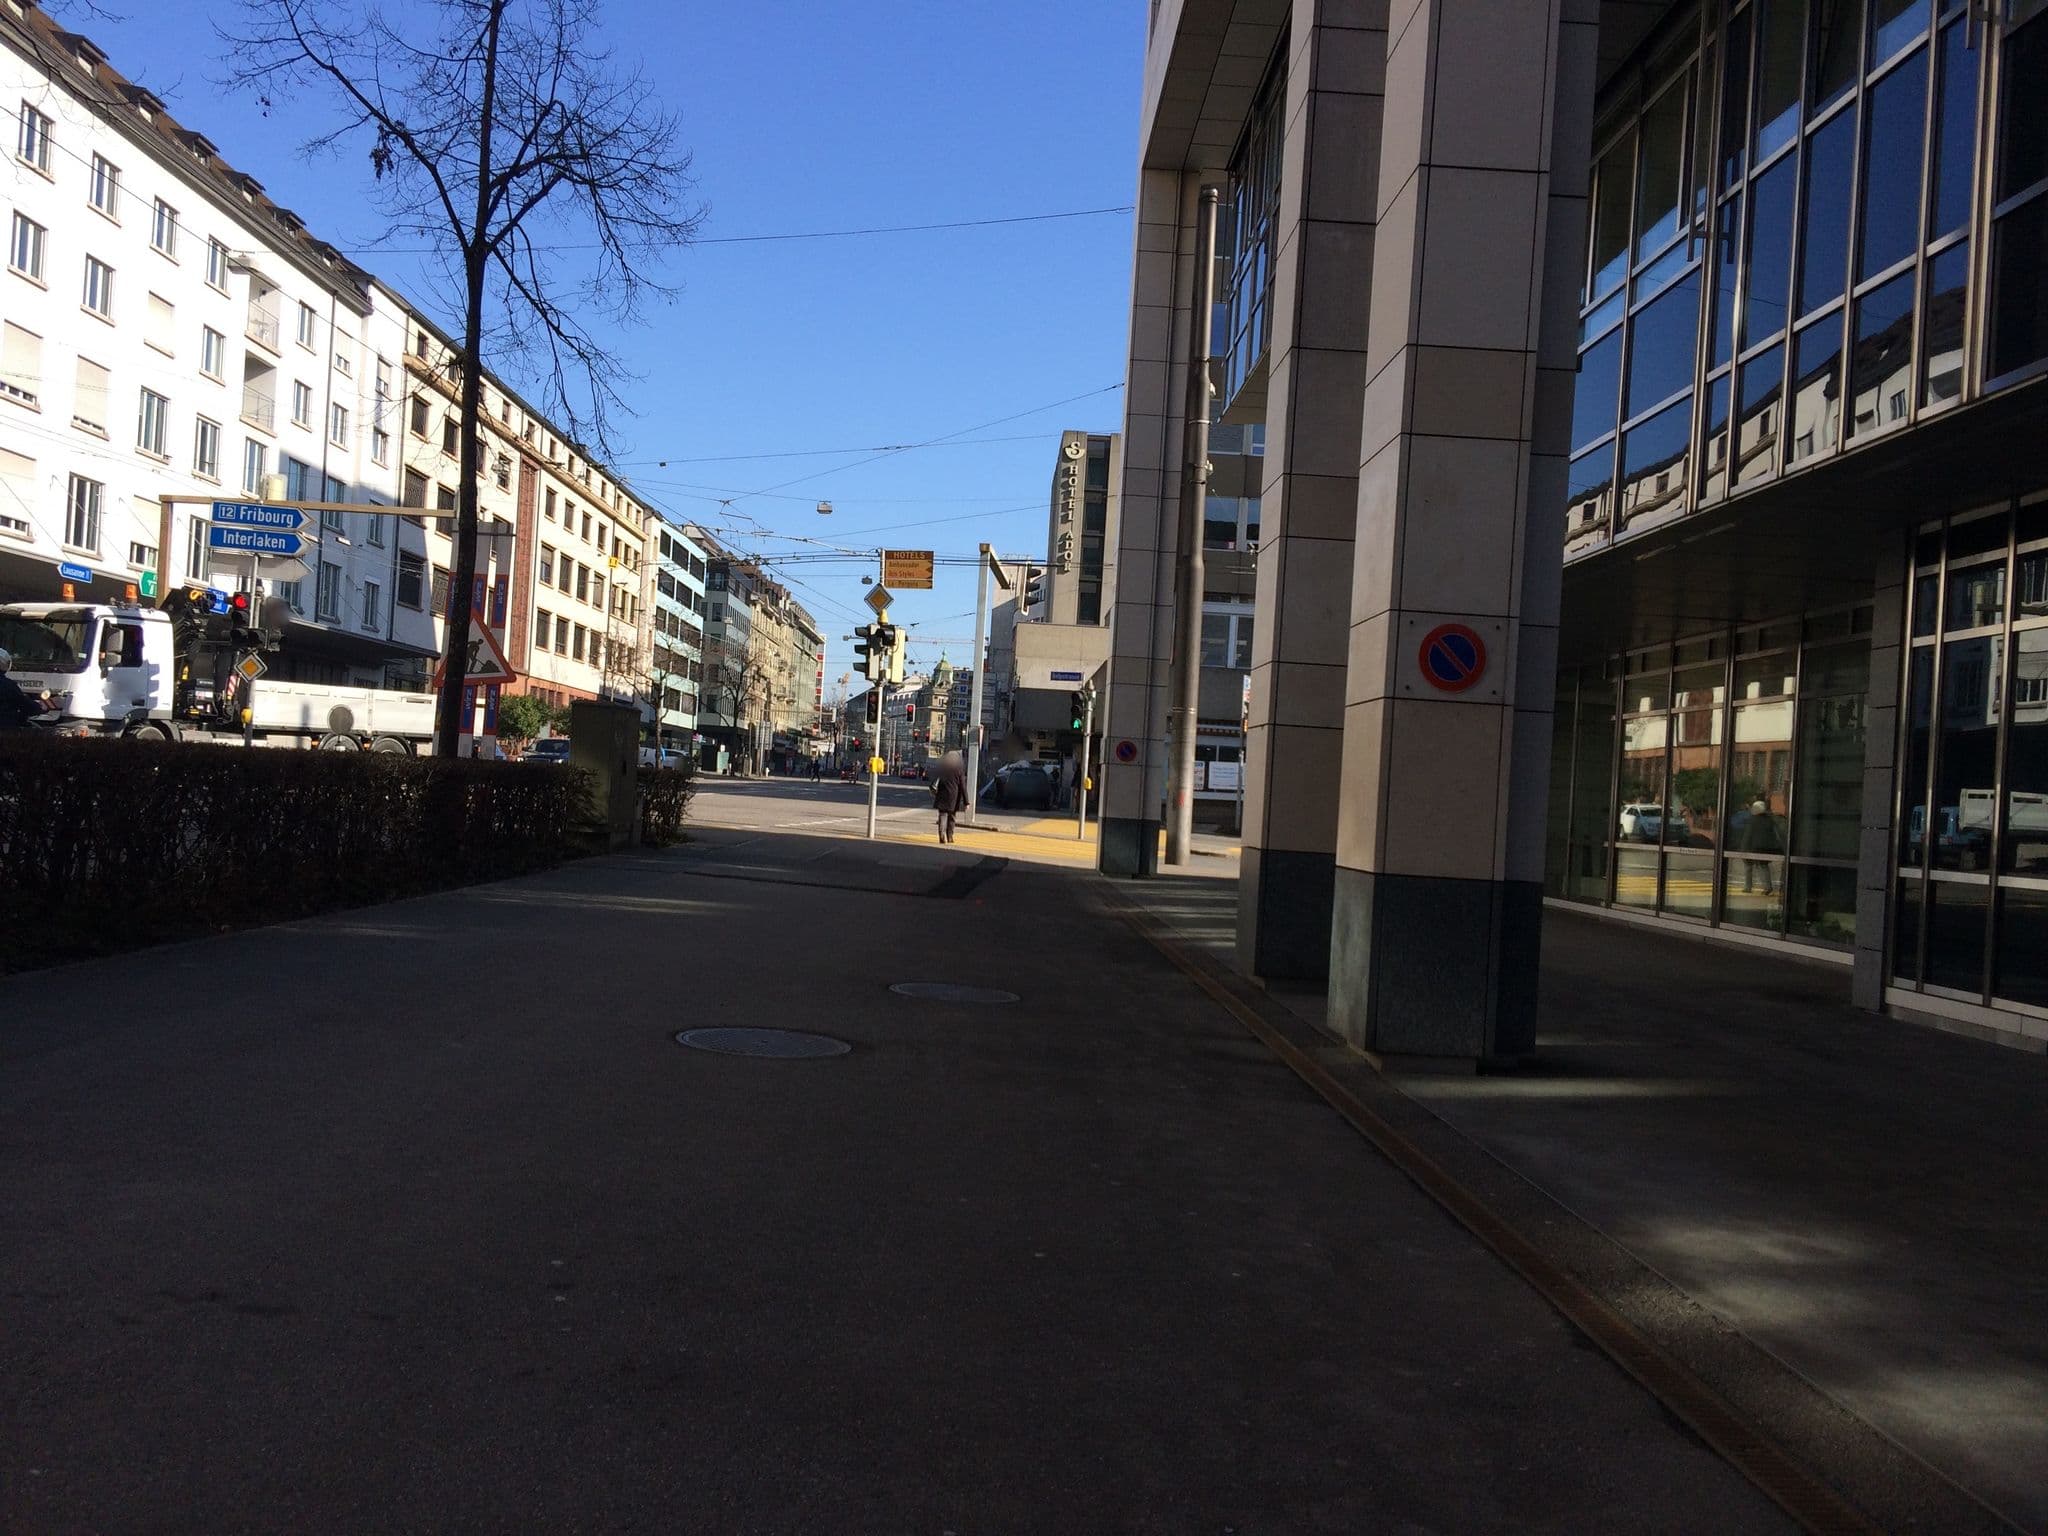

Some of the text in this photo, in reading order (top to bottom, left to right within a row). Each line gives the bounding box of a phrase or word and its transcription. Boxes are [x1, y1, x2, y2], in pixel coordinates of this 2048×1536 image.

[221, 506, 294, 528] 12 Fribourg
[1064, 465, 1080, 571] HOTEL ADOR
[223, 530, 286, 549] Interlaken
[894, 551, 926, 559] HOTELS
